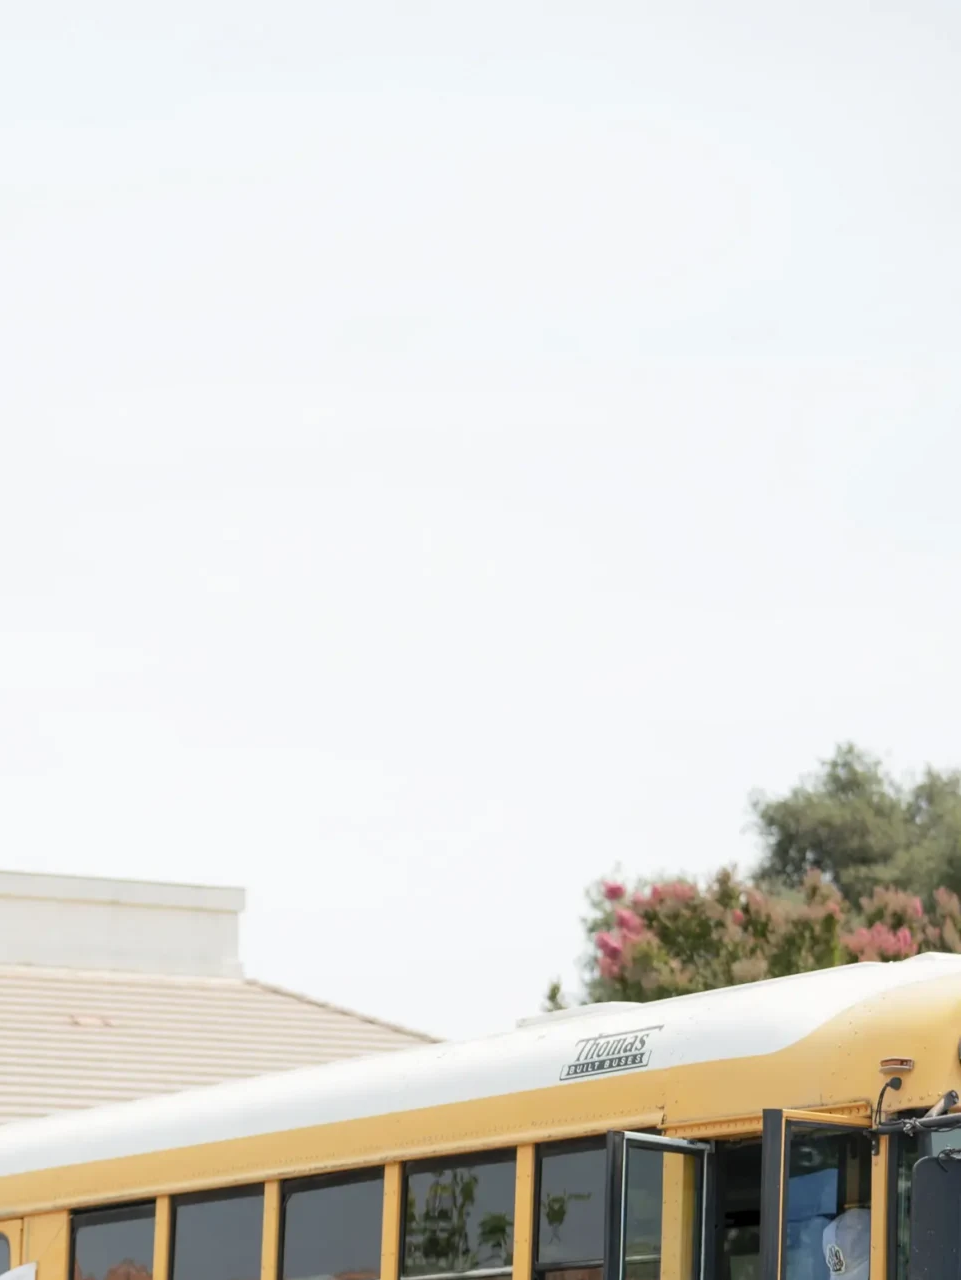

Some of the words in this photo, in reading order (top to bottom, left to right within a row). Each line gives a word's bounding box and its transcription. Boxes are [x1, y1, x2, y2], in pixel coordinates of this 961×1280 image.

[575, 1026, 664, 1062] Thomas
[569, 1064, 599, 1075] BUILT
[604, 1054, 641, 1068] BUSES
